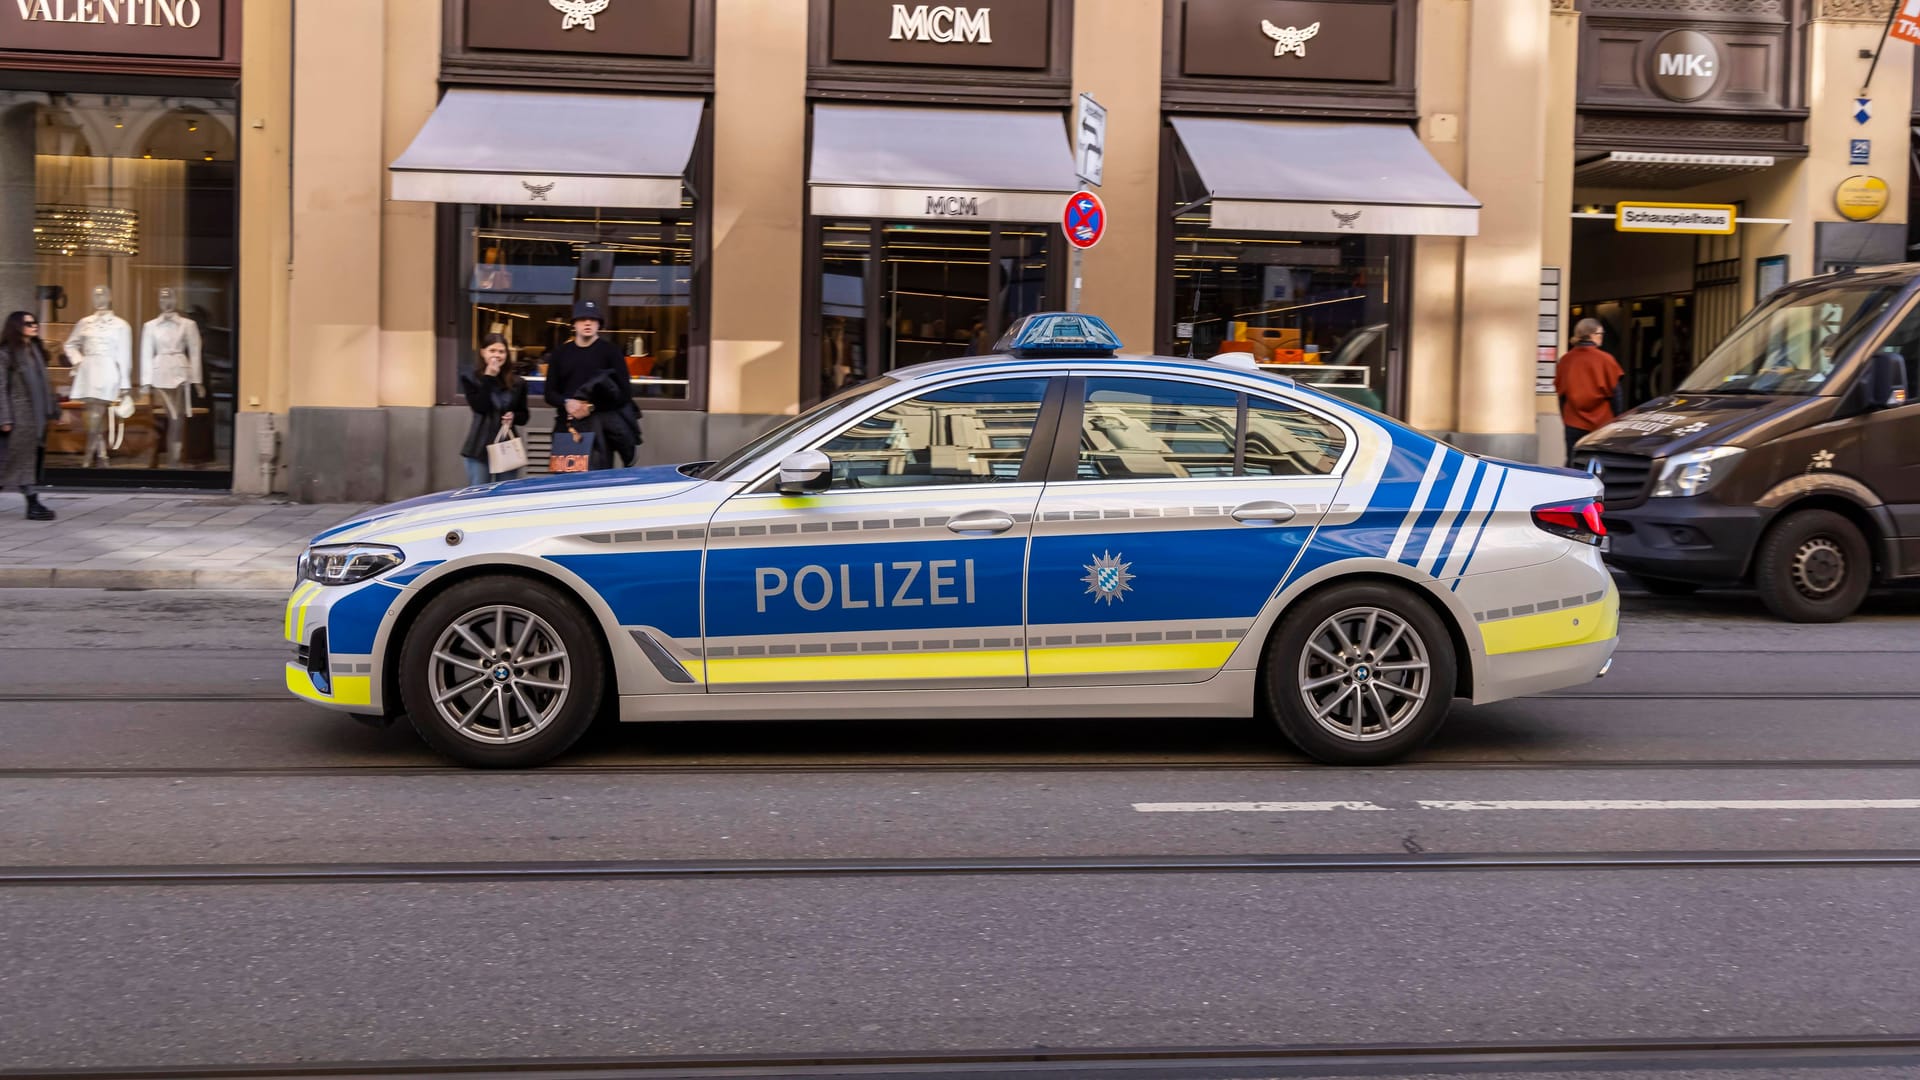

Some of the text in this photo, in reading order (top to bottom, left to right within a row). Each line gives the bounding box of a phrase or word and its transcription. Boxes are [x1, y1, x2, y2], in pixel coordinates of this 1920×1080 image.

[15, 0, 201, 28] VALENTINO
[888, 4, 993, 43] MCM
[1659, 53, 1712, 77] MK:
[925, 196, 978, 215] MCM
[1625, 210, 1726, 226] Schauspielhaus
[755, 558, 976, 613] POLIZEI
